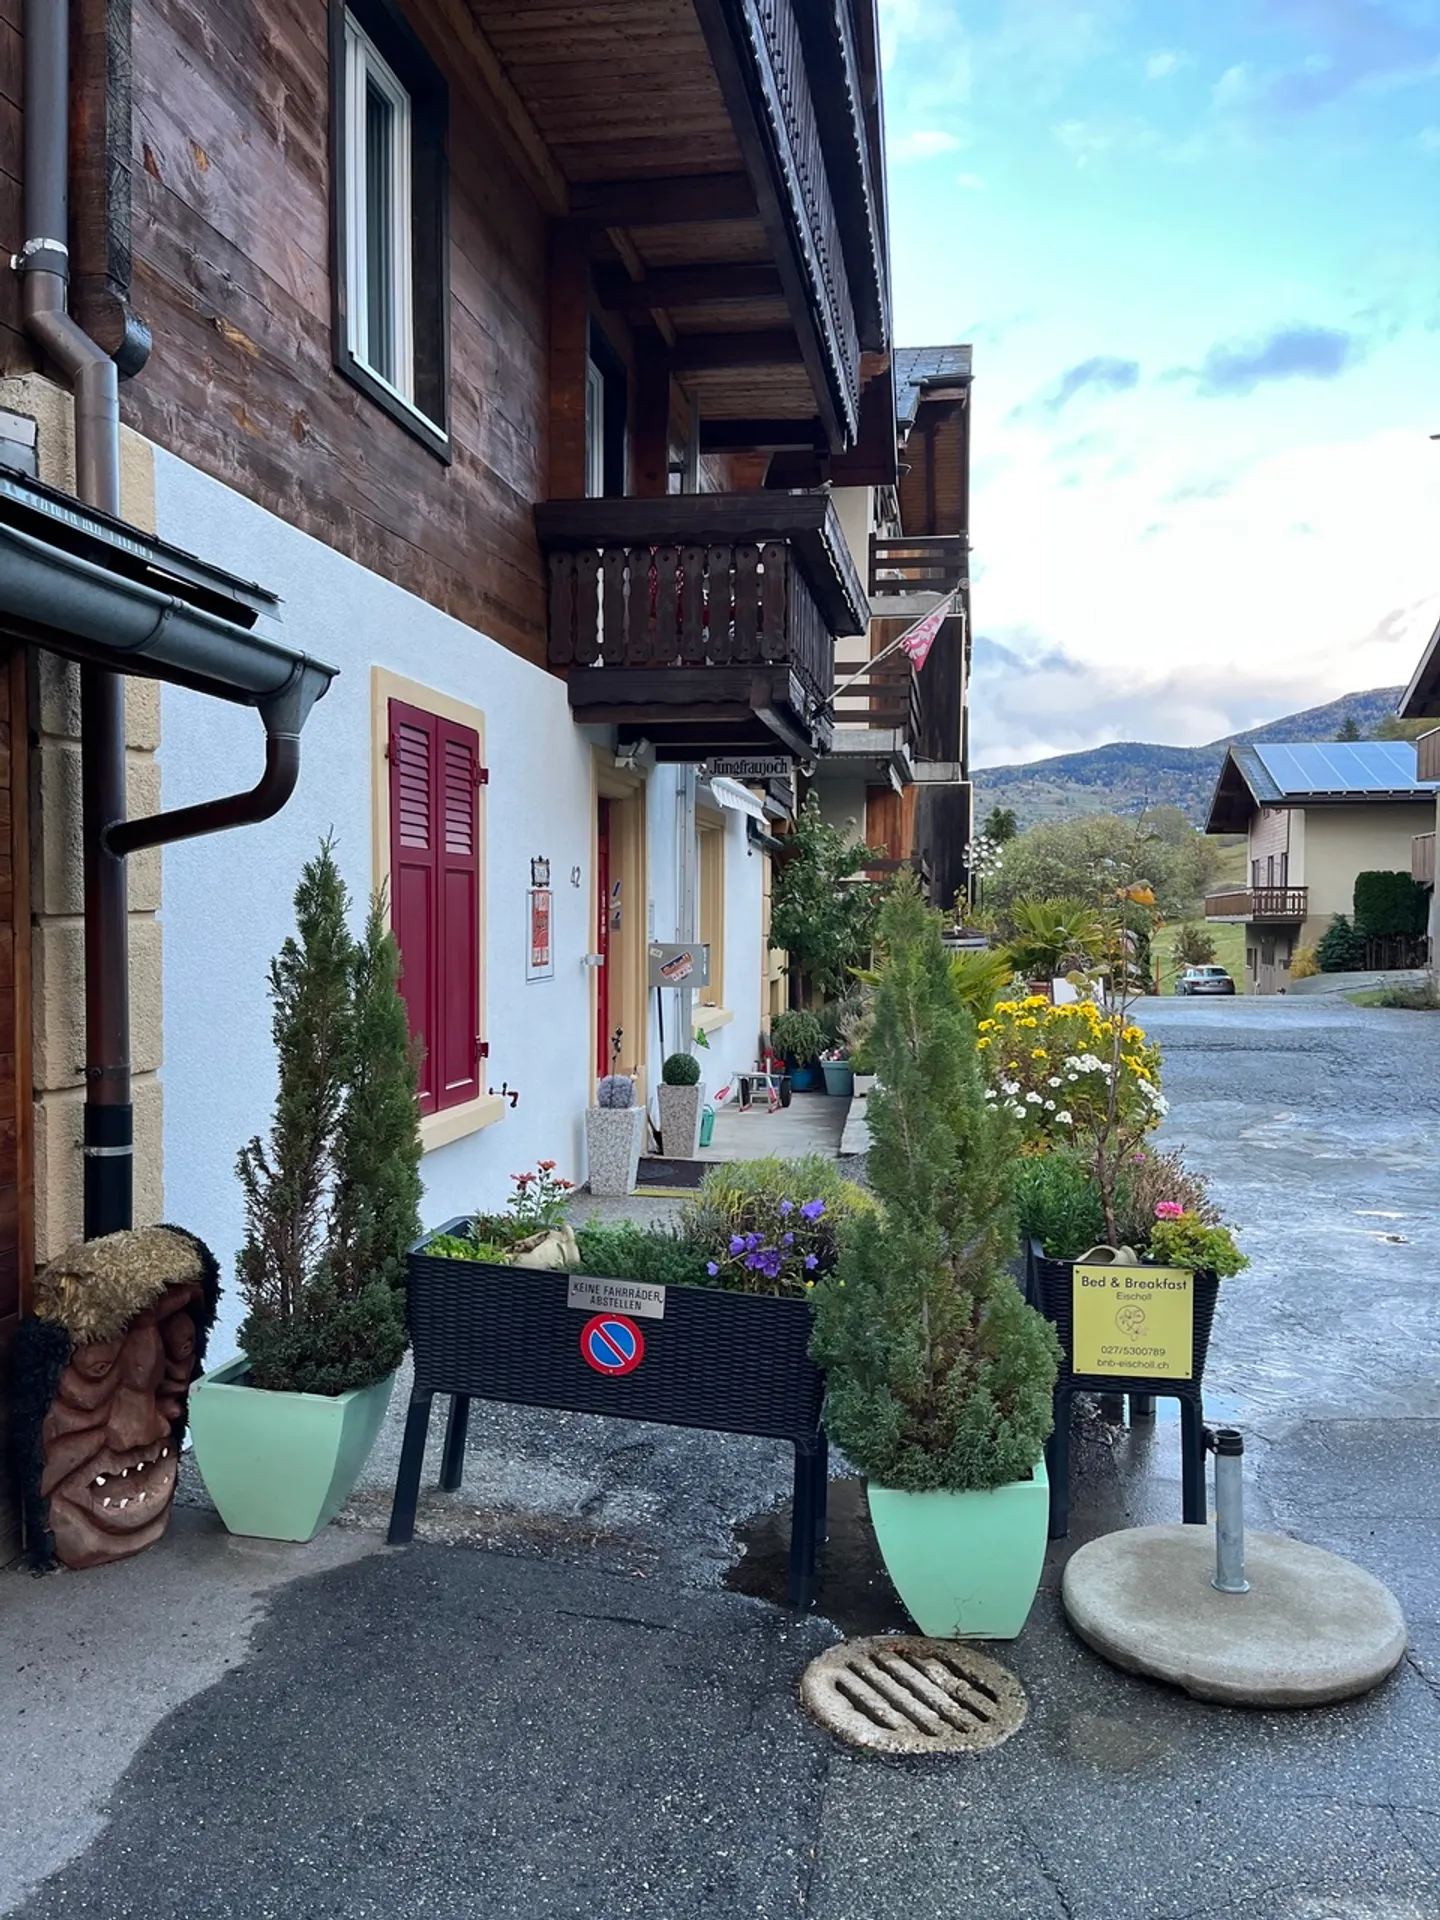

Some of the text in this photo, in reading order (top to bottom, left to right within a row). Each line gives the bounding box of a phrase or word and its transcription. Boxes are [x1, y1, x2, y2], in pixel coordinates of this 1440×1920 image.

[710, 757, 788, 776] Jungfraujoch
[570, 866, 581, 888] 42
[1081, 1275, 1187, 1290] Bed & Breakfast
[573, 1282, 660, 1301] KEINE FAHRRÄDER
[1116, 1292, 1152, 1301] Eischoll
[590, 1296, 642, 1310] ABSTELLEN
[1101, 1345, 1166, 1356] 027/5300789
[1097, 1358, 1170, 1370] bnb-eischoll.ch
